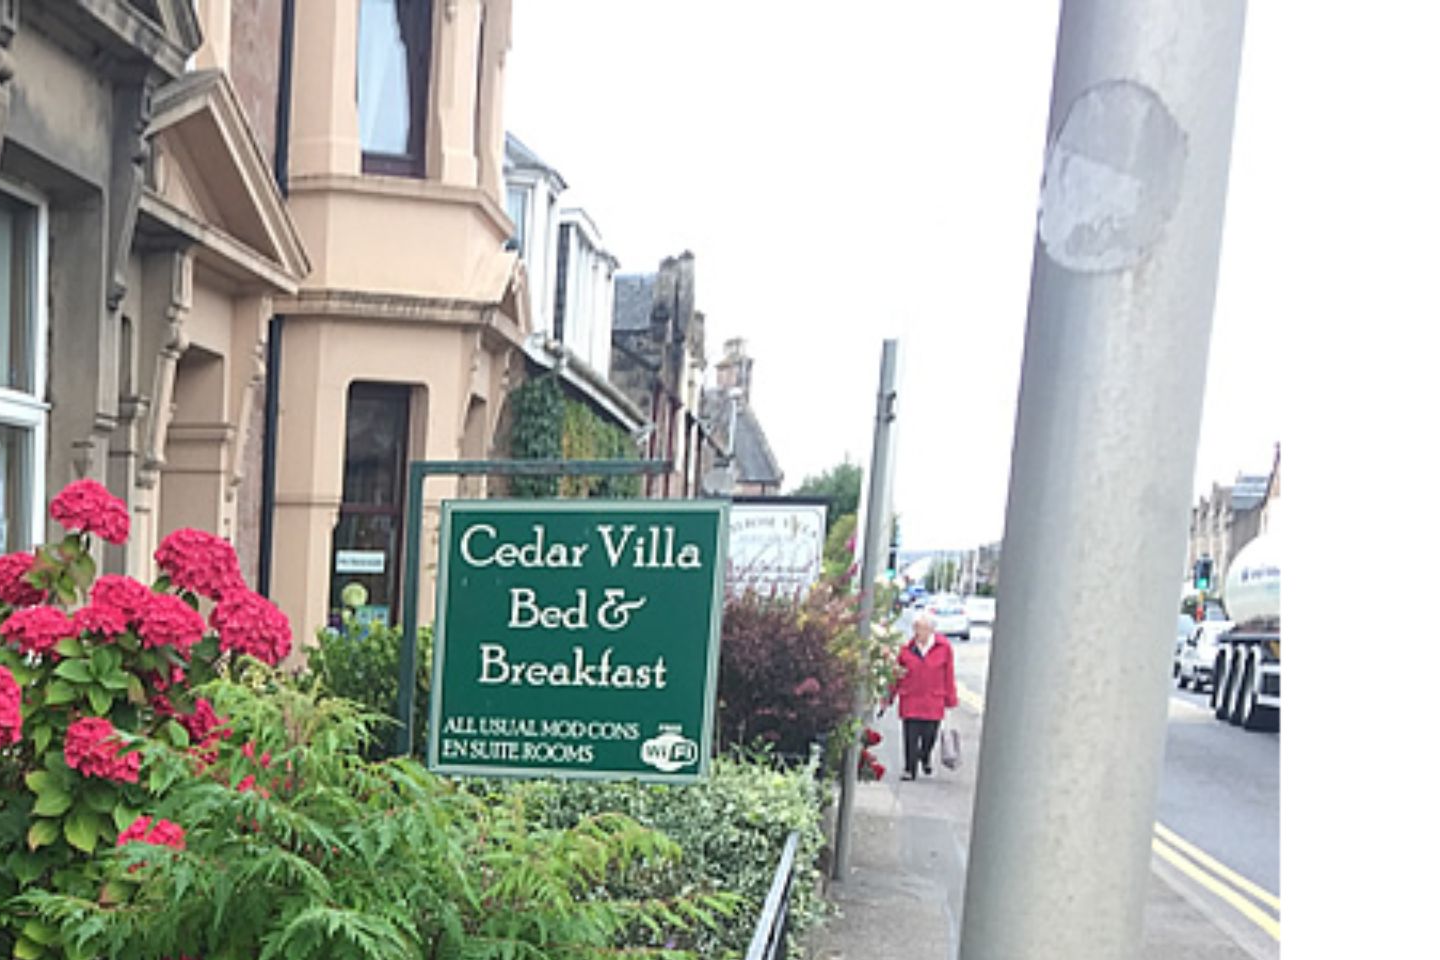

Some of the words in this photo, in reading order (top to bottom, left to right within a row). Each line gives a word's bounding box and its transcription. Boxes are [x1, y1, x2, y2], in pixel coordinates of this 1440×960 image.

[460, 523, 589, 568] Cedar
[596, 524, 702, 568] Villa
[508, 588, 588, 629] Bed
[596, 588, 647, 629] &
[478, 643, 667, 689] Breakfast
[444, 716, 478, 734] ALL
[479, 717, 538, 737] USUAL
[540, 719, 586, 739] MOD
[587, 721, 640, 740] CONS
[442, 738, 468, 757] EN
[469, 739, 521, 760] SUITE
[522, 742, 594, 763] ROOMS
